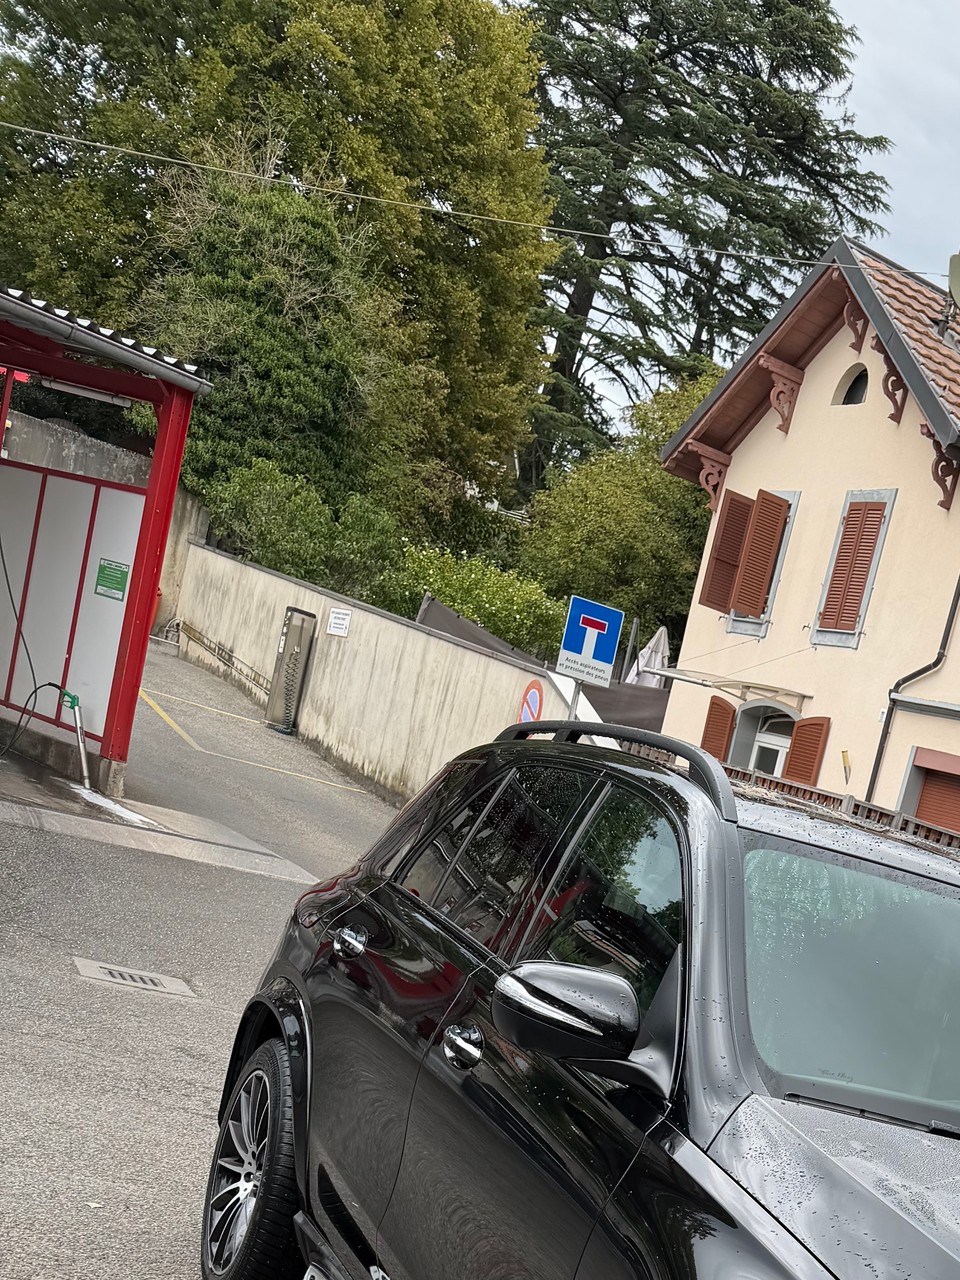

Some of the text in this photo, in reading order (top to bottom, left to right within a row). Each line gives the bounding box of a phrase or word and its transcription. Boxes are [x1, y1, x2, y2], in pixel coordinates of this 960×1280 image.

[565, 657, 605, 674] Accès aspirateurs
[565, 664, 585, 674] pression
[595, 674, 608, 682] pneus
